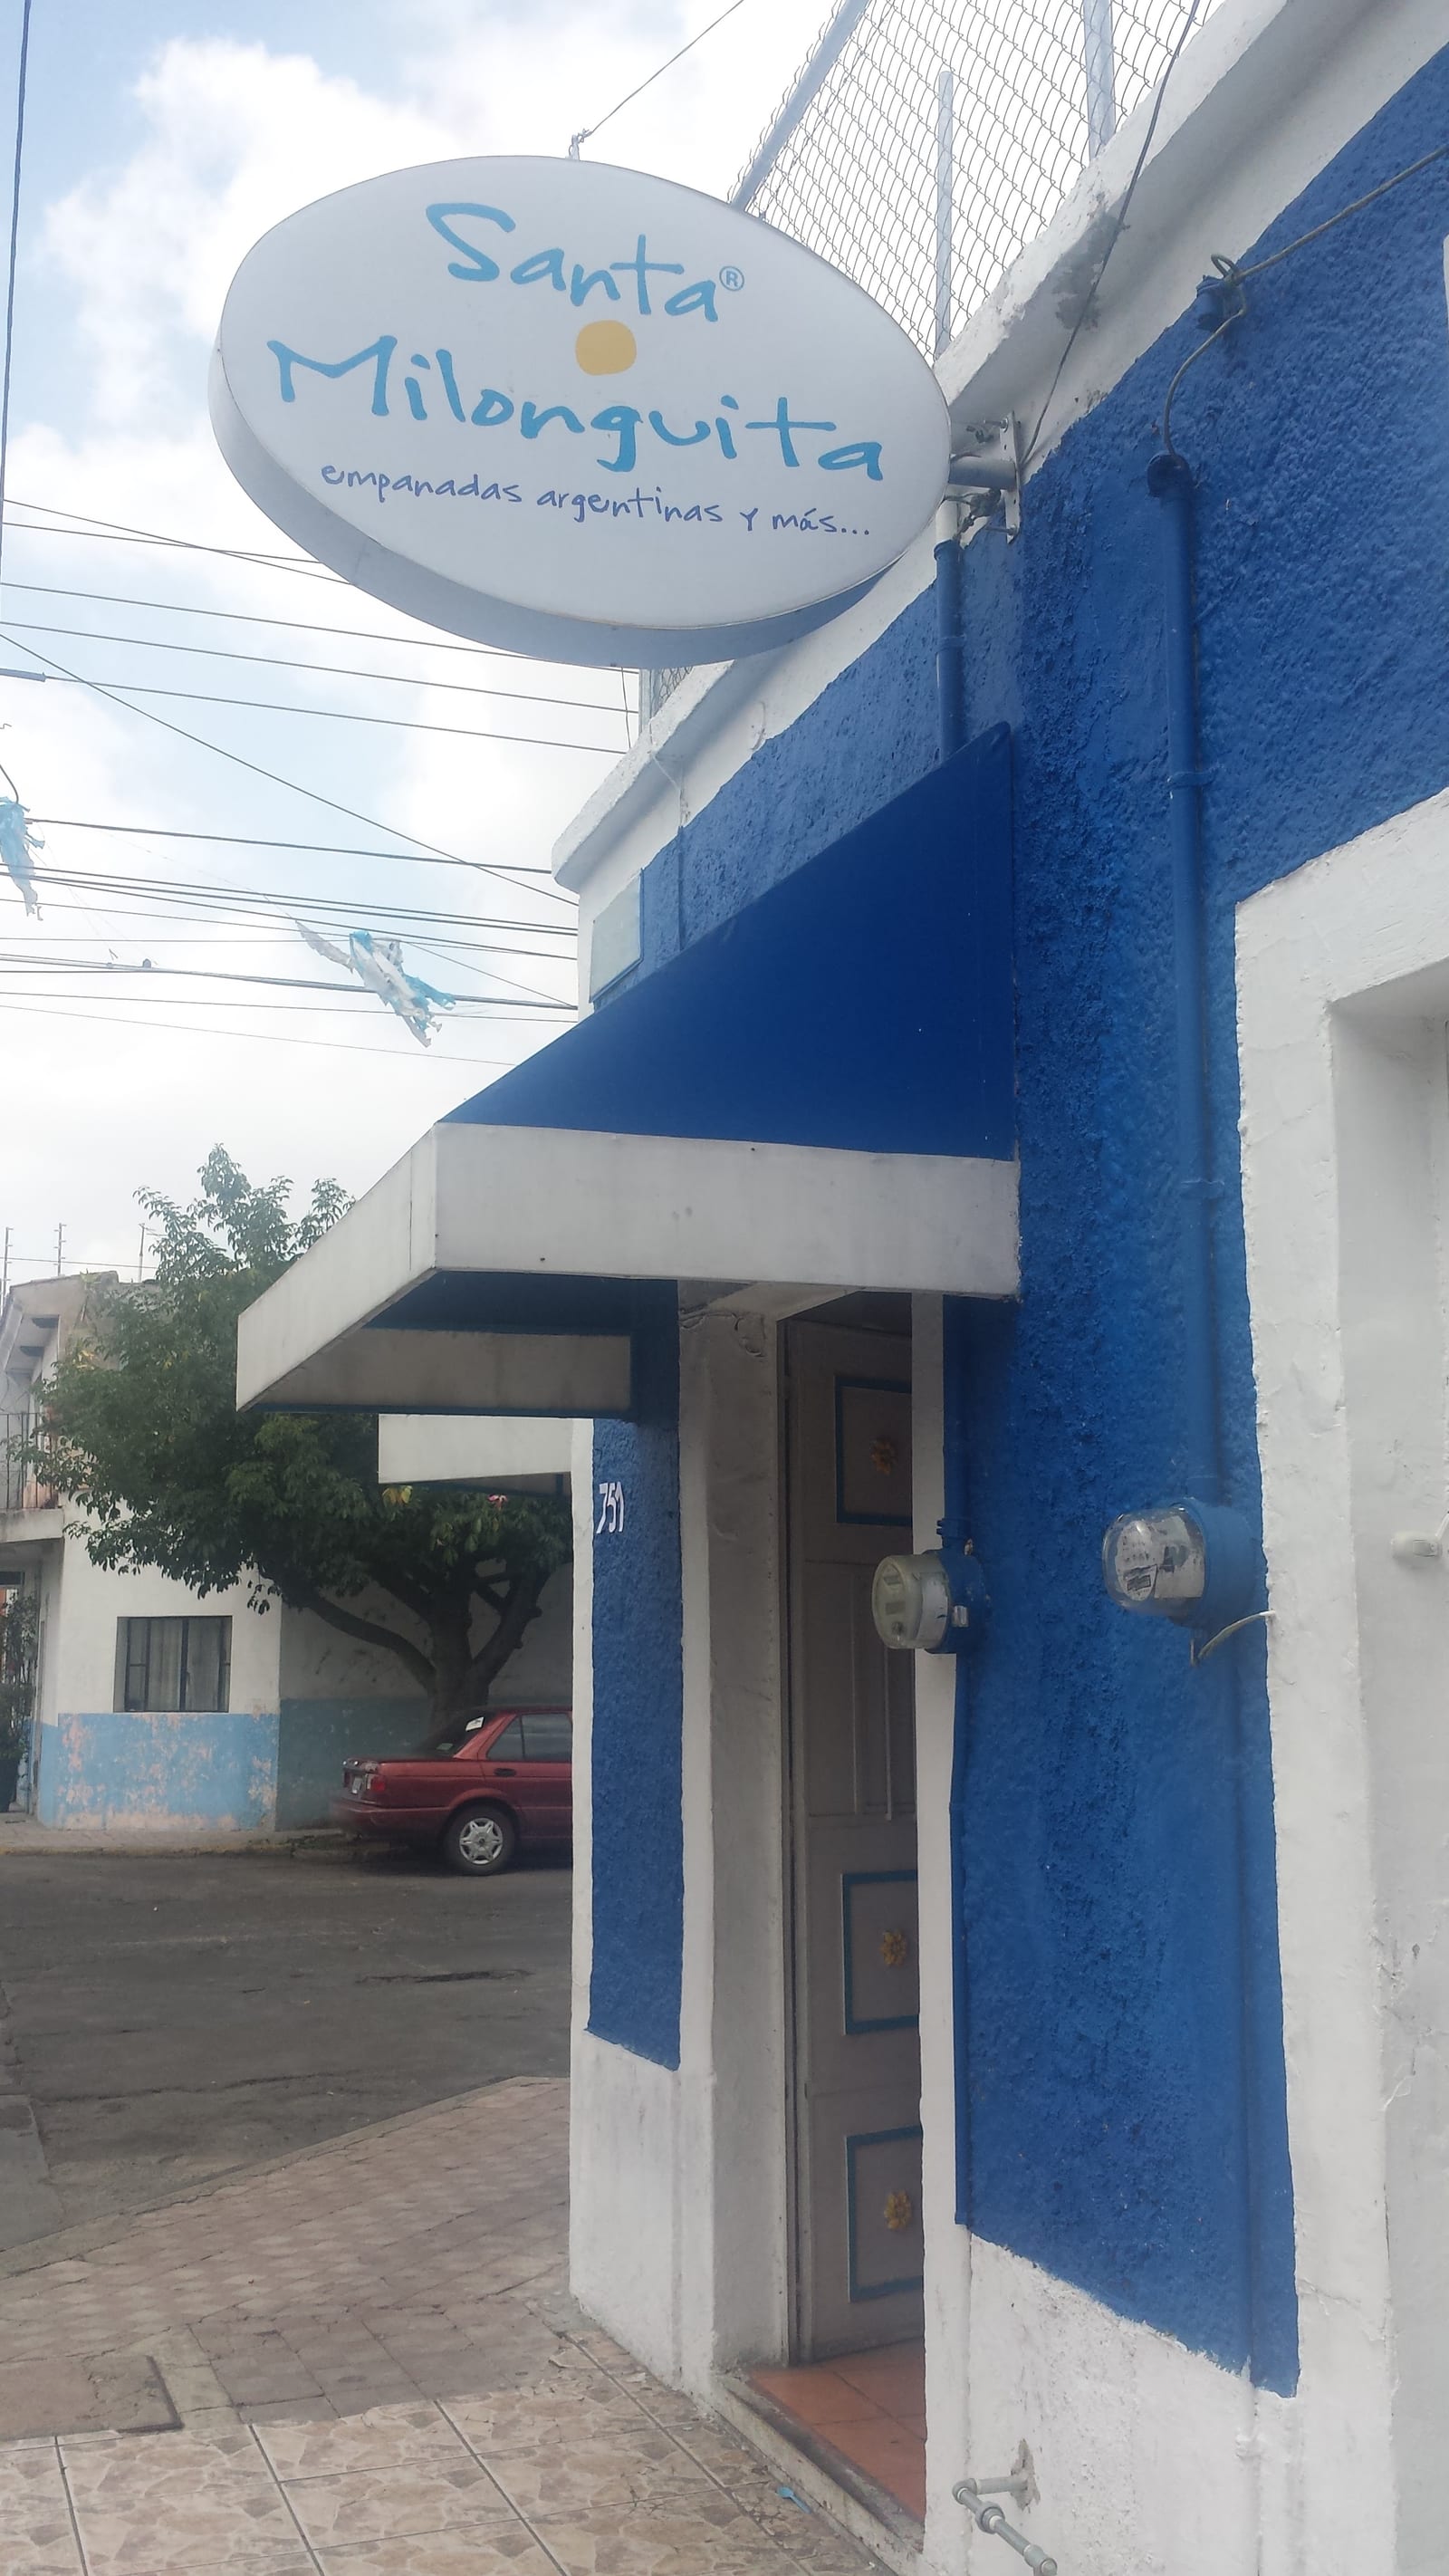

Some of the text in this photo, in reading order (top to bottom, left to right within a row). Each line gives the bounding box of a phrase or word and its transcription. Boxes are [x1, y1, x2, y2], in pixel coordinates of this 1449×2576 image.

[264, 332, 886, 484] Milonguita
[320, 463, 523, 505] empanadas
[535, 485, 724, 524] argentinas
[595, 1481, 626, 1534] 751
